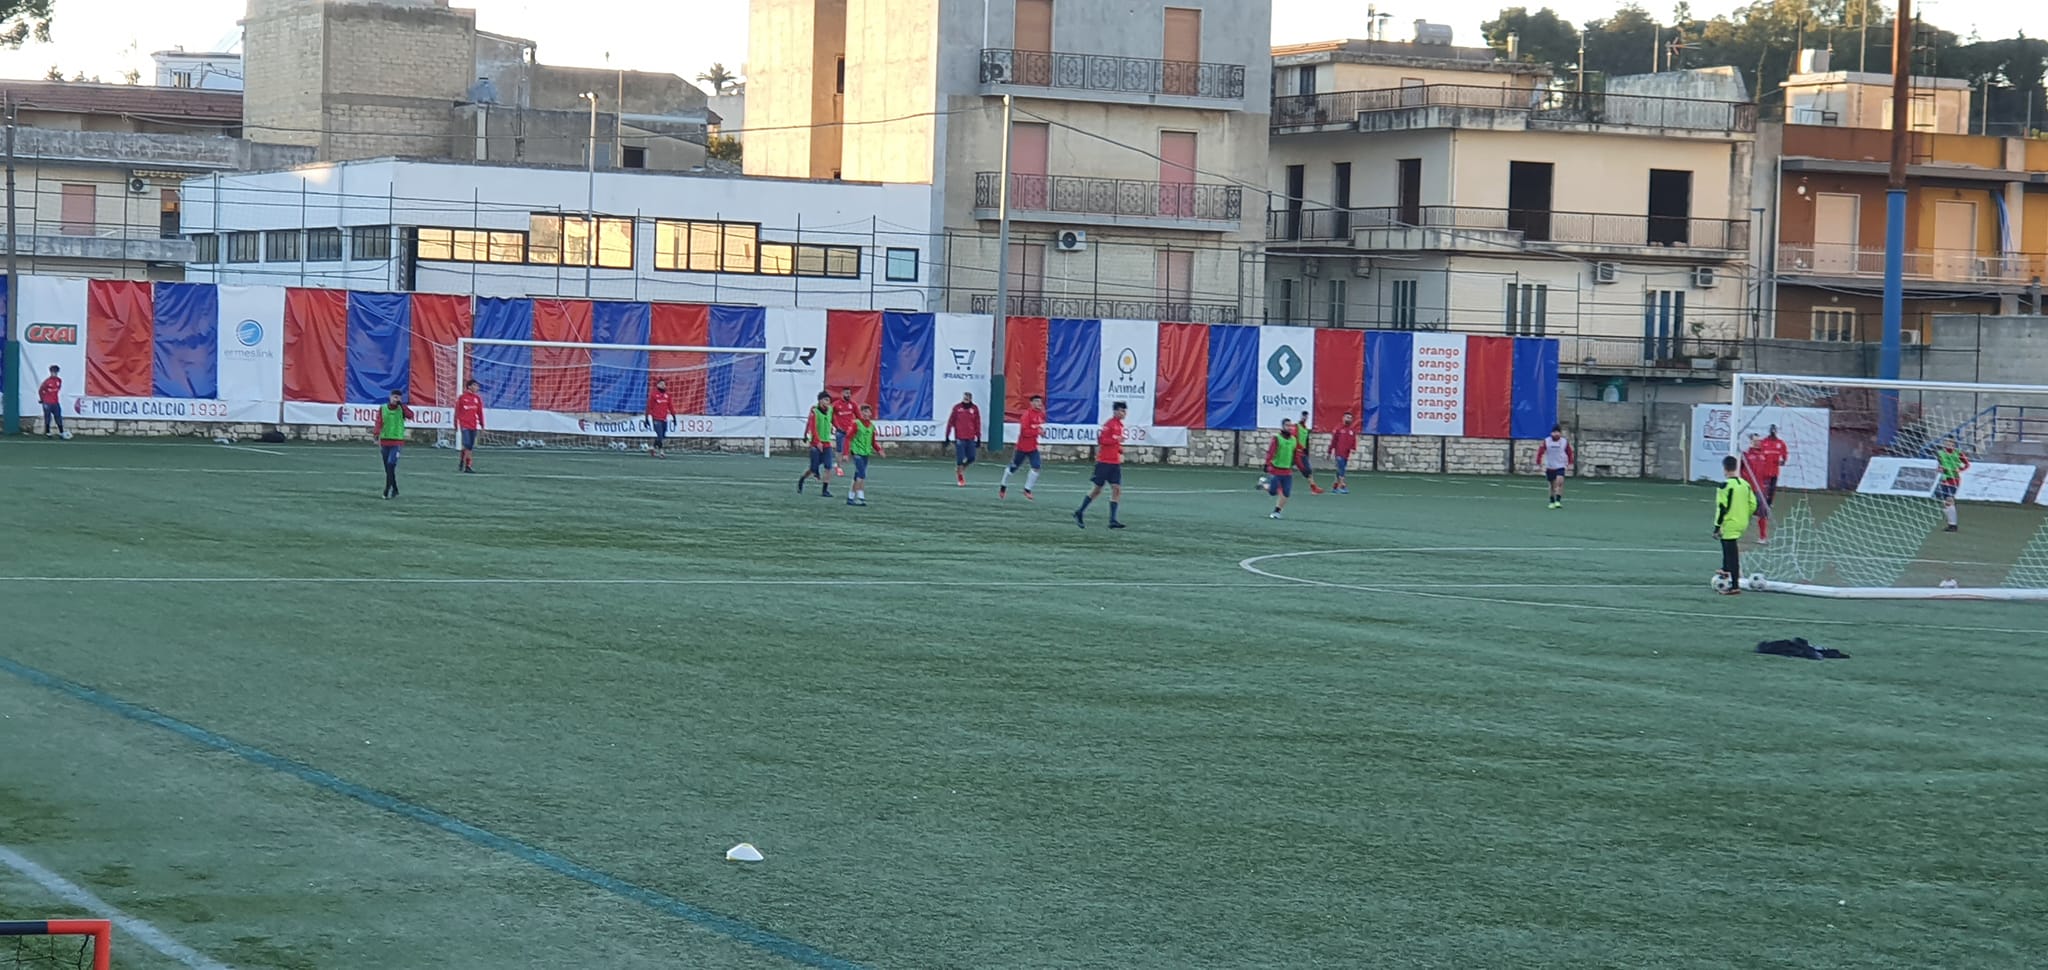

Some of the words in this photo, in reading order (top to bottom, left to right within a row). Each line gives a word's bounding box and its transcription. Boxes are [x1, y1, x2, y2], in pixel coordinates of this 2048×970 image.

[27, 325, 76, 343] CRAI
[775, 346, 818, 366] DR
[1419, 347, 1460, 359] orango
[1418, 360, 1460, 372] orango
[1417, 373, 1459, 385] orango
[1417, 386, 1458, 397] orango
[1262, 393, 1308, 407] sughero
[1417, 399, 1458, 410] orango
[92, 400, 138, 415] MODICA
[142, 401, 186, 416] CALCIO
[190, 402, 228, 417] 1932
[411, 410, 441, 425] LCIO
[1416, 411, 1457, 423] orango
[680, 420, 713, 433] 1932
[1041, 427, 1075, 440] ODICA
[1123, 428, 1147, 441] 932
